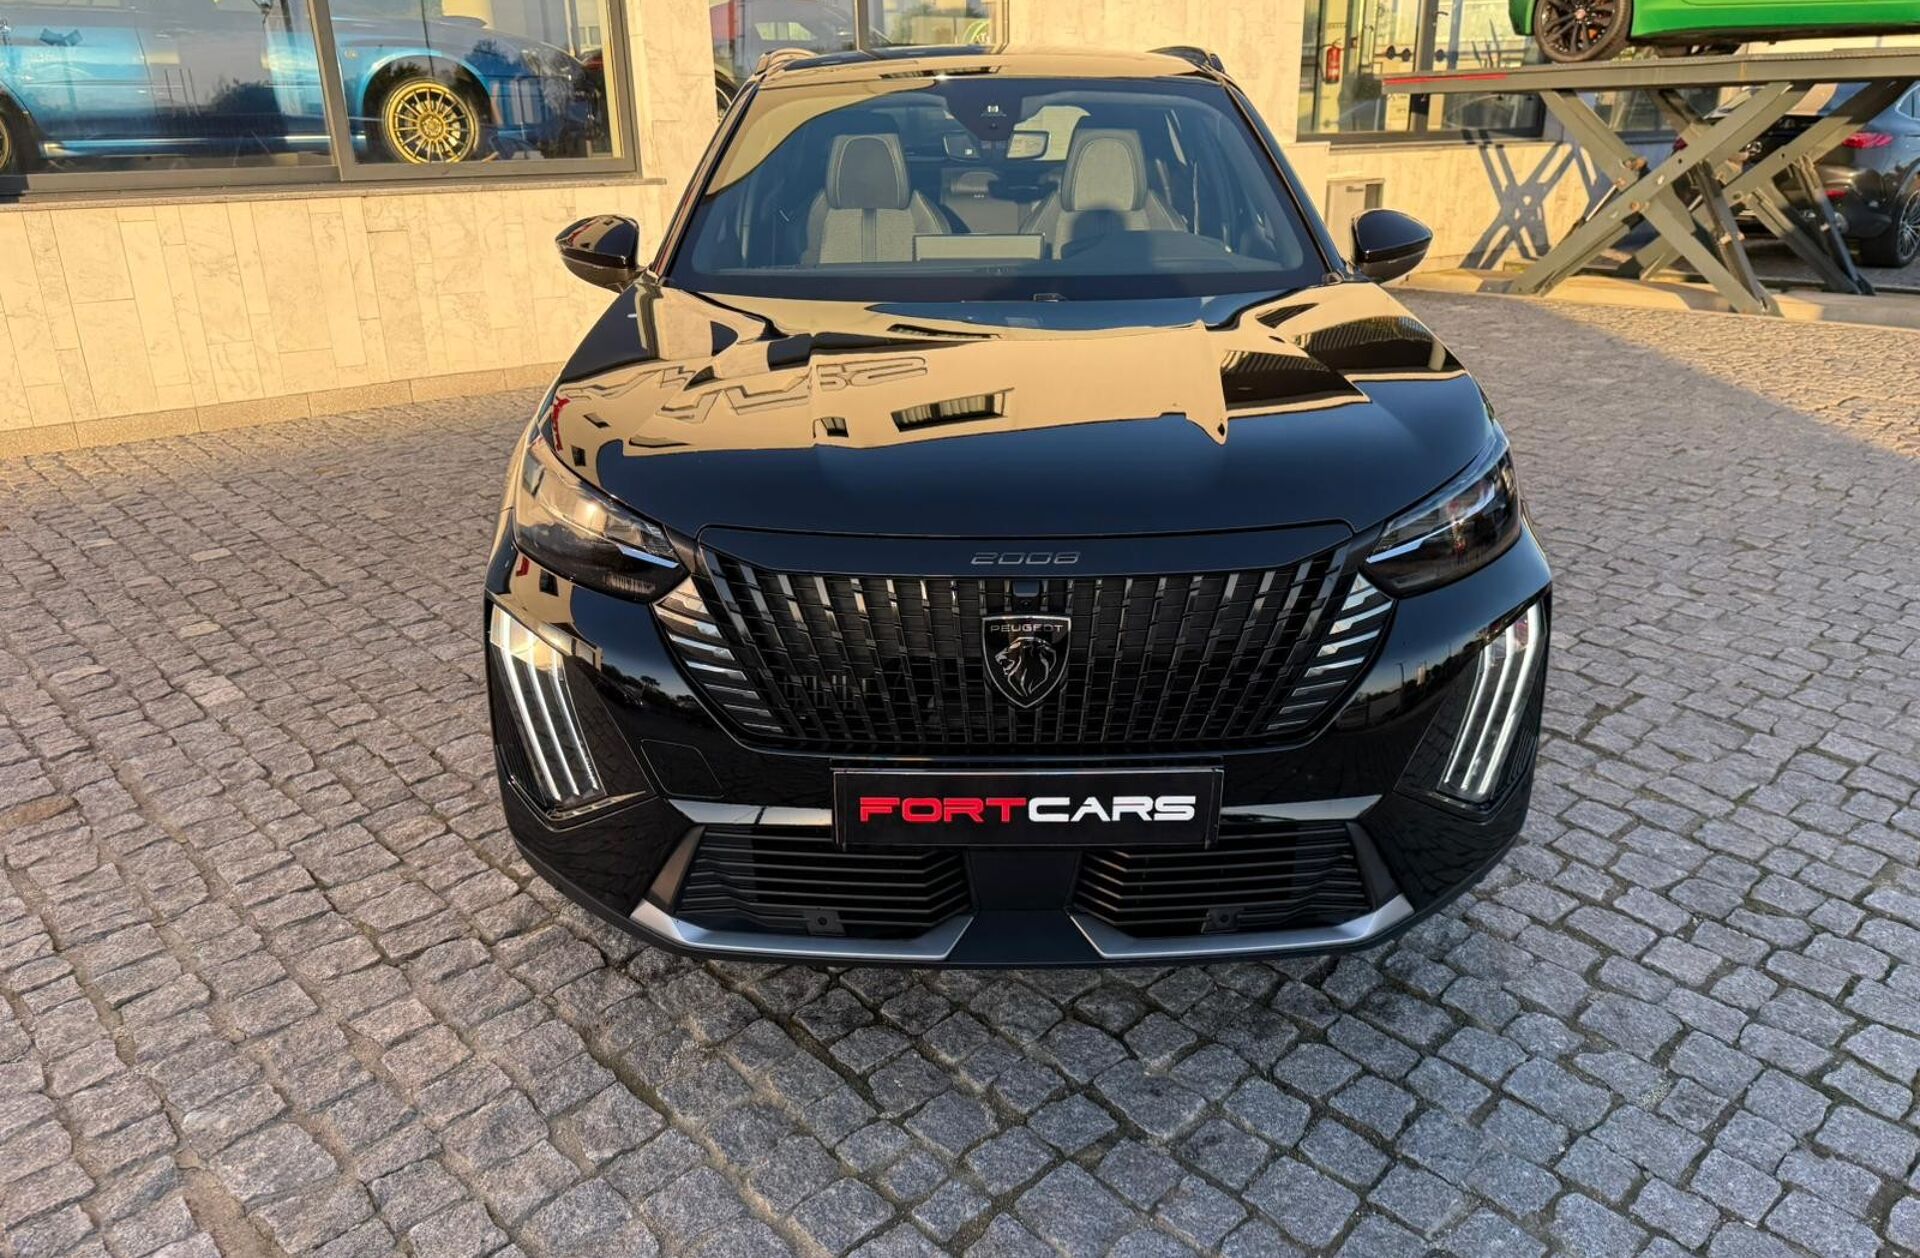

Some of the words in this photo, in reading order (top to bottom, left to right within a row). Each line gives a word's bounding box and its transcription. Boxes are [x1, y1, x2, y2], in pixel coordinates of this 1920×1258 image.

[970, 551, 1081, 565] 2008
[990, 623, 1064, 633] PEUGEOT
[859, 795, 1197, 823] FORTCARS
